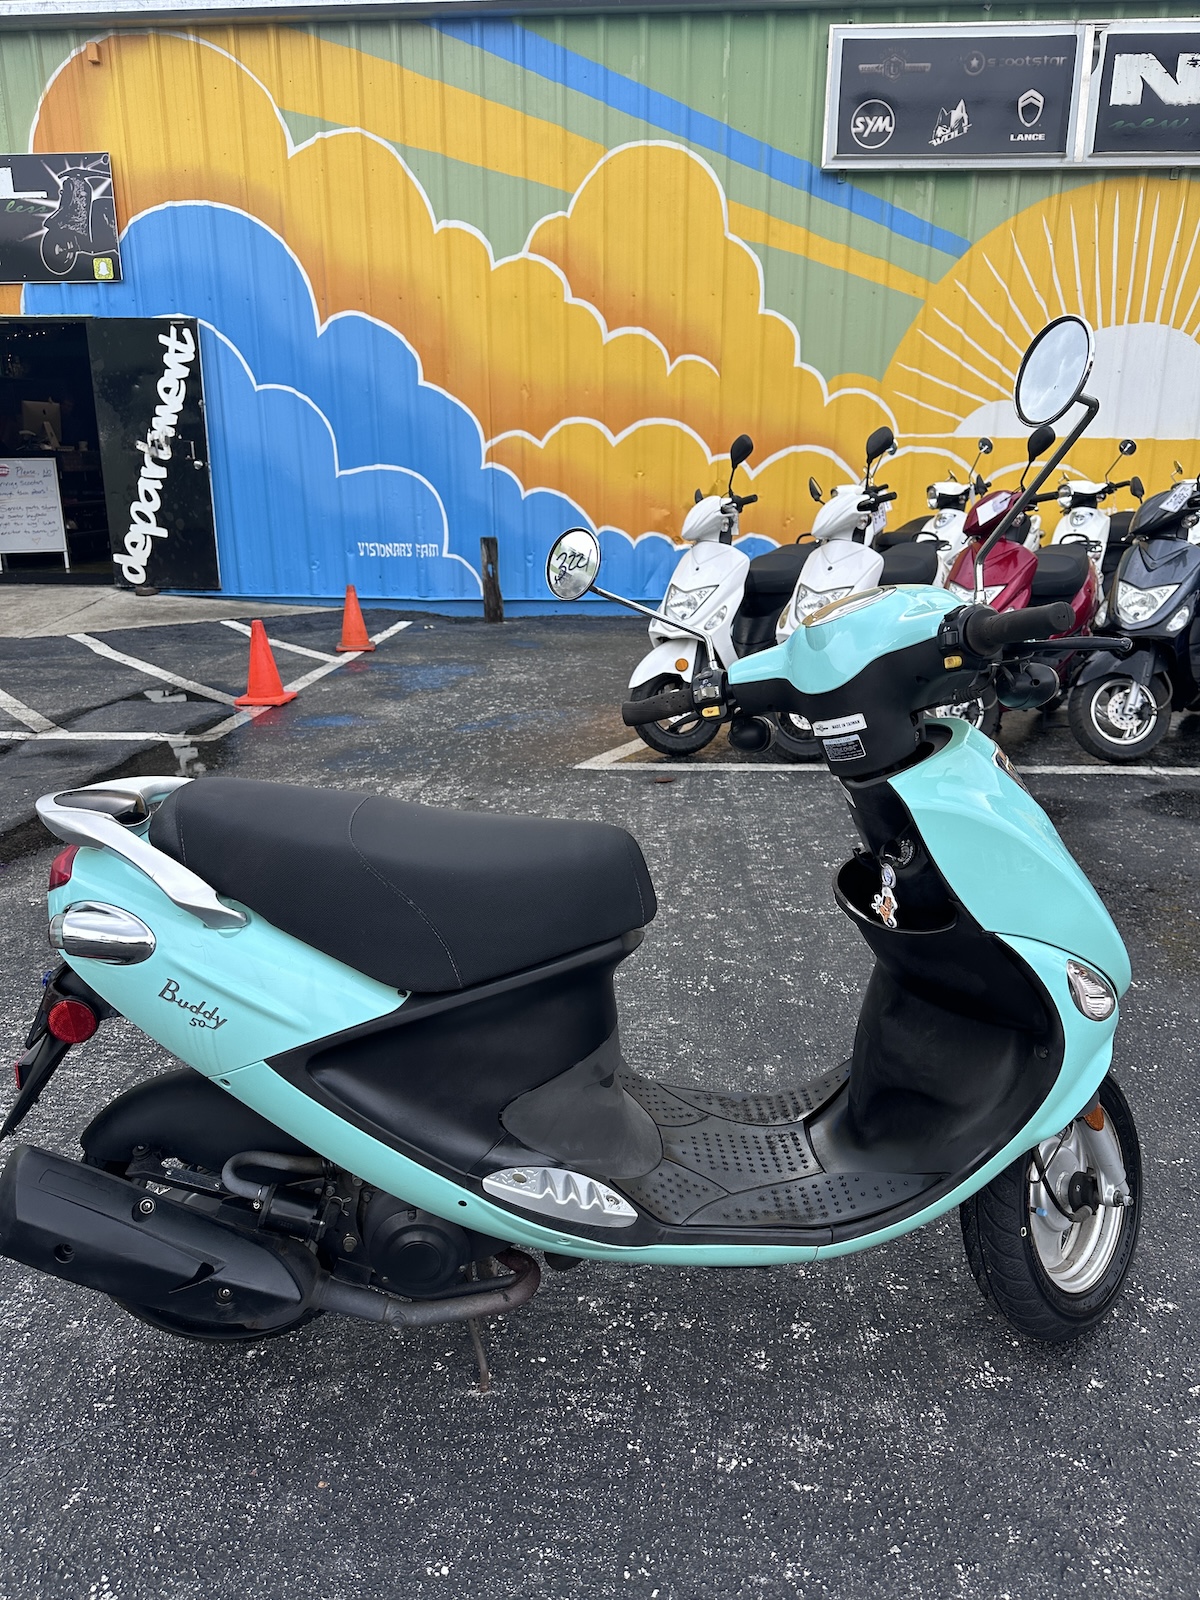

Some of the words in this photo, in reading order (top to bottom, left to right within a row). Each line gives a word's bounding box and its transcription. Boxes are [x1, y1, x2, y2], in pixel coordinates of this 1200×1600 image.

[853, 116, 892, 138] SYM
[1108, 117, 1190, 131] new
[1010, 133, 1045, 141] LANCE
[4, 200, 48, 213] less
[113, 326, 195, 584] department
[357, 542, 413, 557] VISIONARY
[415, 543, 439, 558] FAM
[158, 977, 228, 1030] Buddy
[189, 1017, 206, 1028] 50
